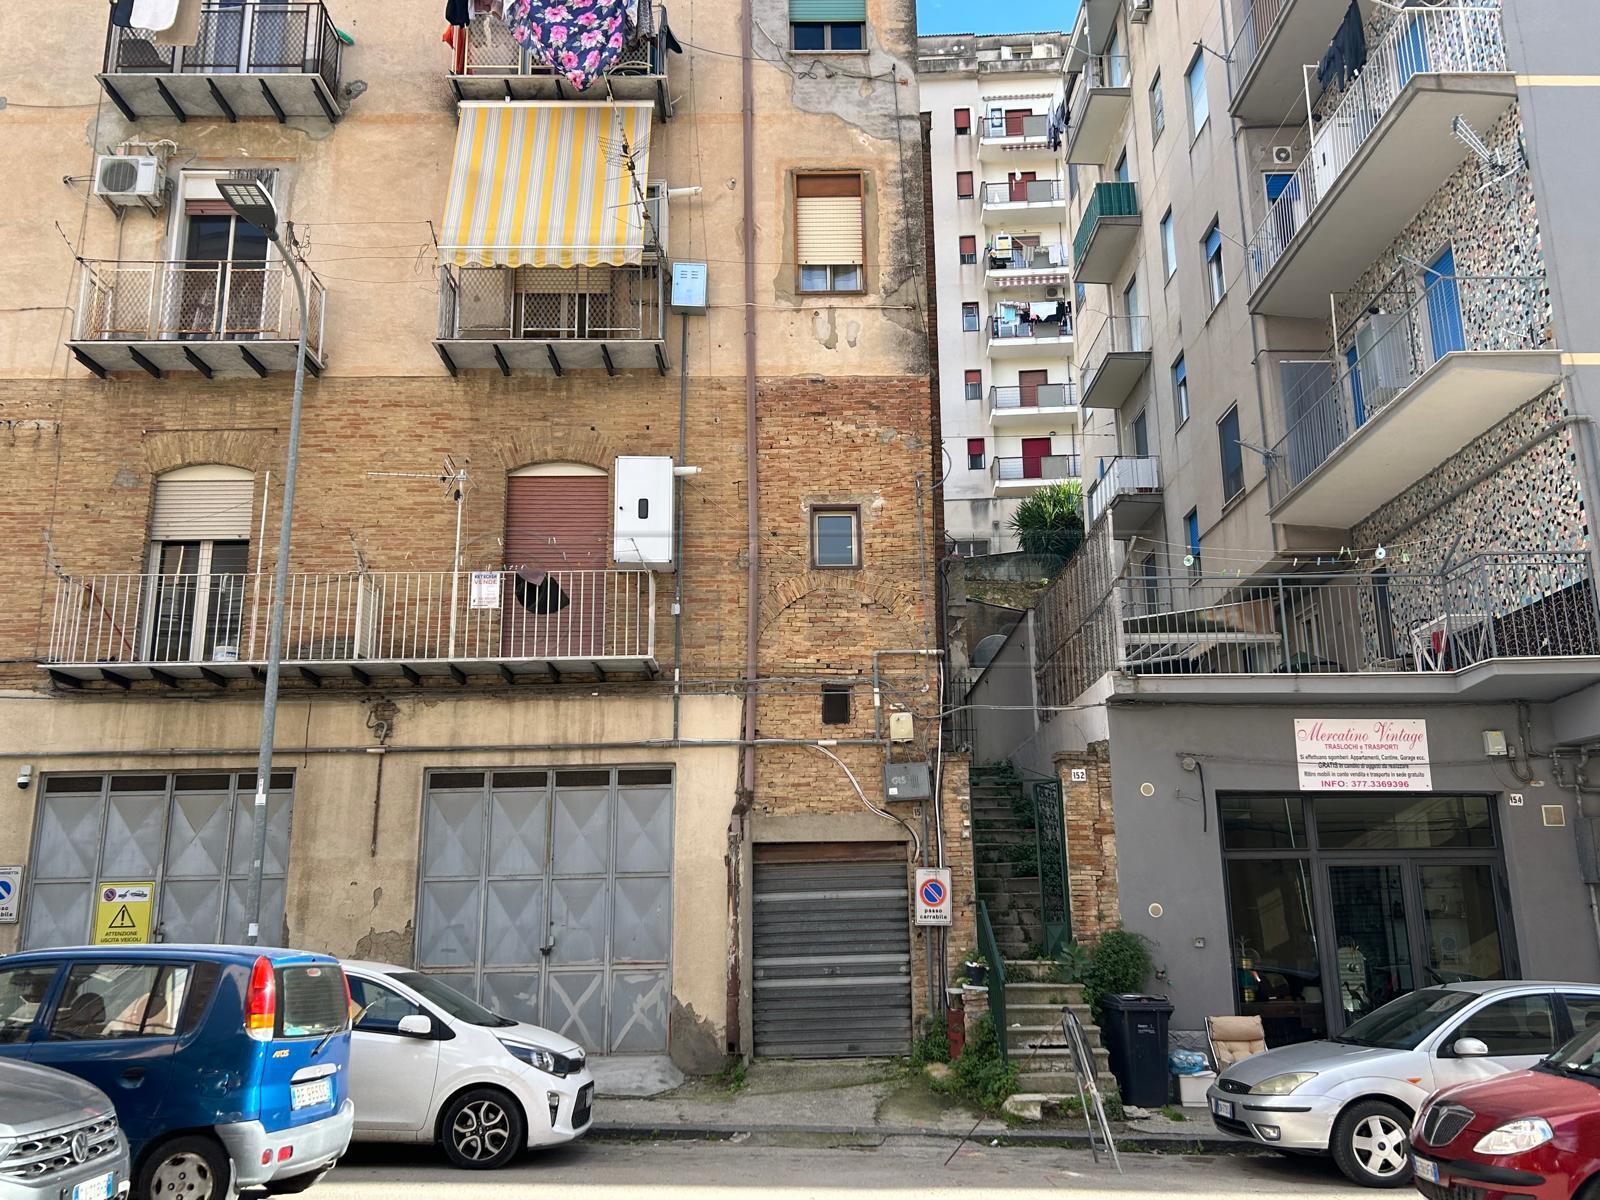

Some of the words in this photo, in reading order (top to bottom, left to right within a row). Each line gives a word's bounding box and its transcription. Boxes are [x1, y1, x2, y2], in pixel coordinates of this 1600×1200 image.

[1297, 721, 1369, 741] Mercatino
[1373, 721, 1424, 750] Vintage
[1073, 771, 1085, 780] 152
[1321, 780, 1349, 788] INFO:
[1351, 780, 1410, 788] 377.3369396
